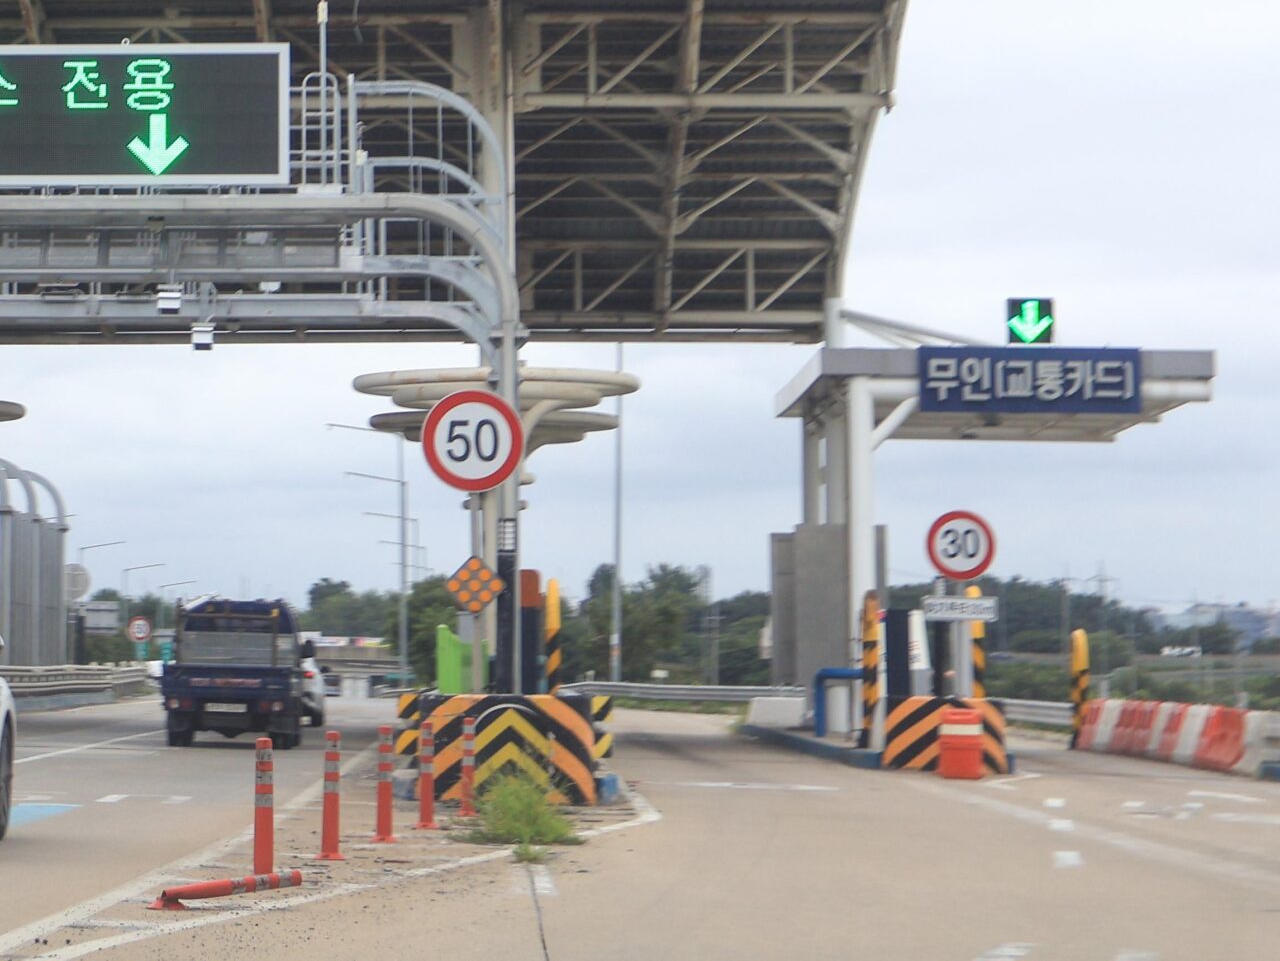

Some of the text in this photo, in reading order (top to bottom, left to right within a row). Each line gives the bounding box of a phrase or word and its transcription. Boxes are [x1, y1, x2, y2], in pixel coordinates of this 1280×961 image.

[61, 58, 175, 112] 전용
[446, 419, 498, 463] 50
[941, 528, 980, 559] 30
